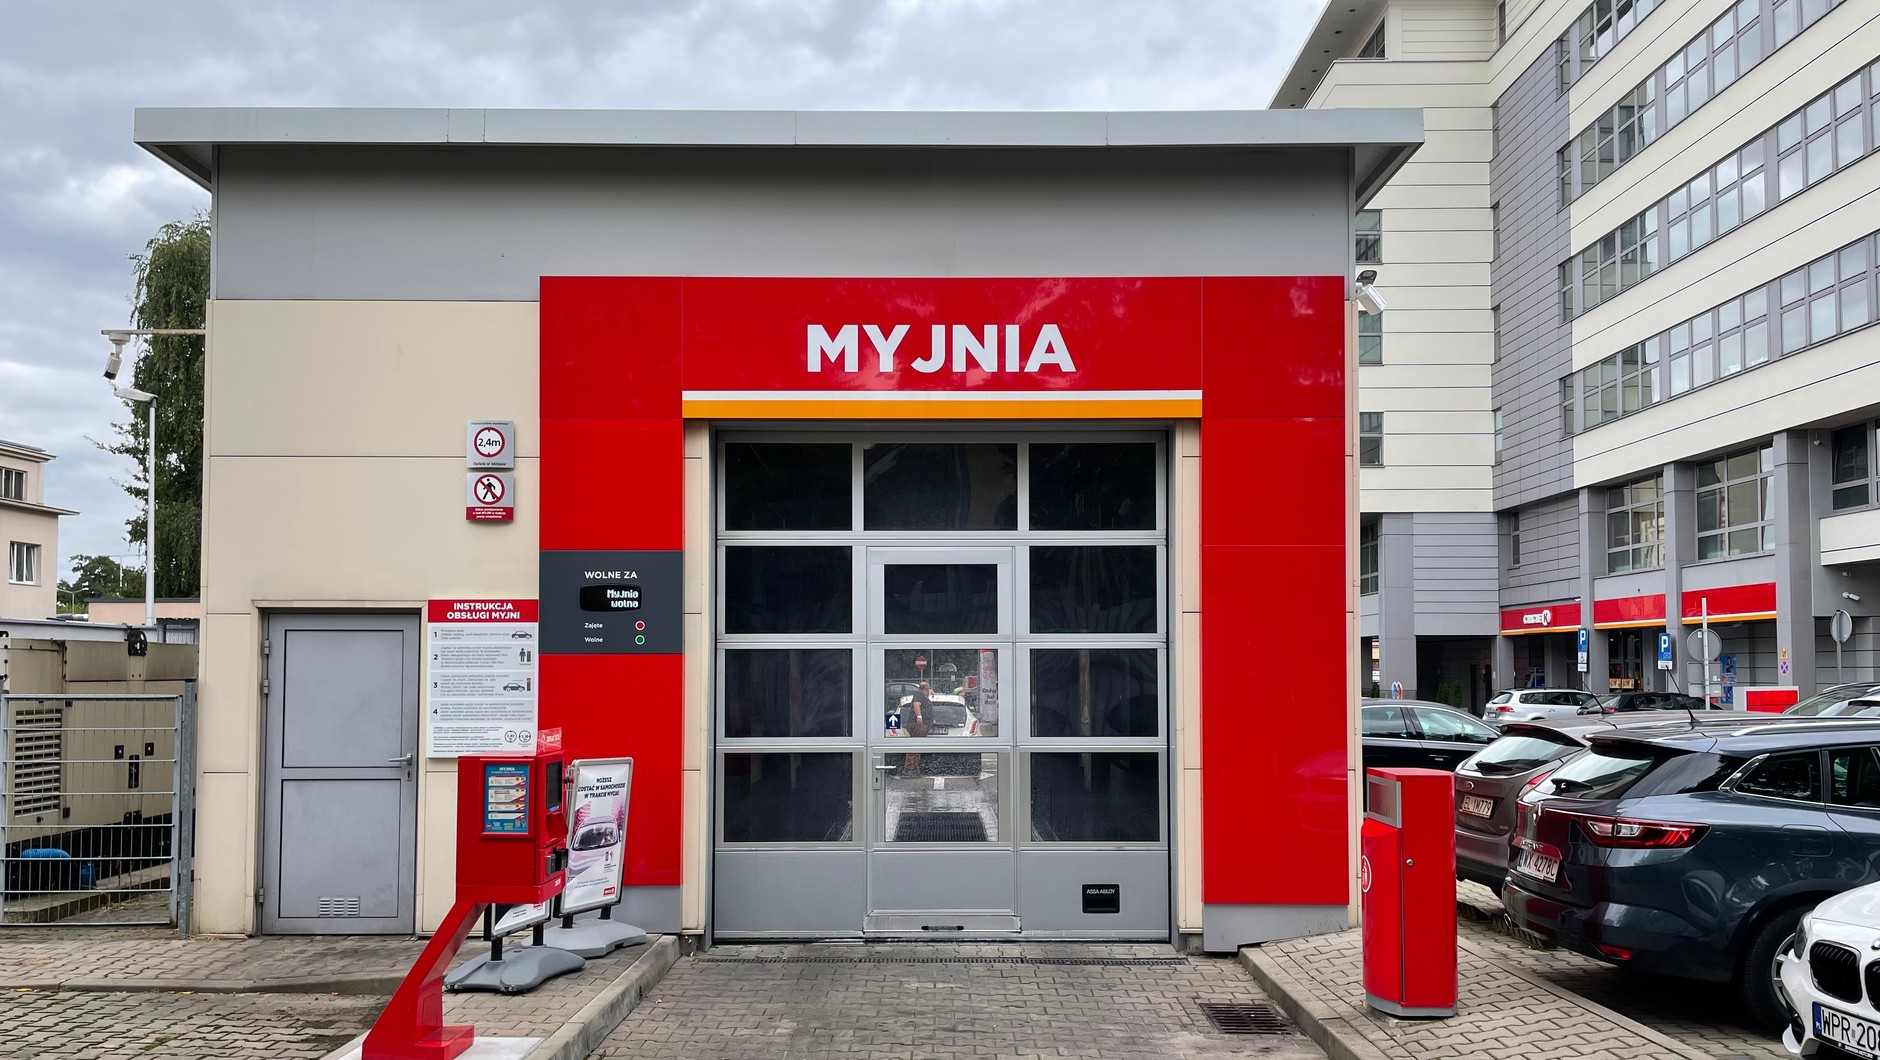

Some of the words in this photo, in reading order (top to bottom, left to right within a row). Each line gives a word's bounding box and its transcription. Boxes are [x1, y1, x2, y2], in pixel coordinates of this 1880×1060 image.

[807, 324, 1077, 373] MYJNIA
[478, 438, 501, 448] 2,4m
[584, 571, 621, 579] WOLNE
[623, 571, 638, 579] ZA
[453, 602, 513, 611] INSTRUKCJA
[610, 600, 639, 608] wolna
[446, 611, 489, 619] OBSŁUGI
[491, 611, 520, 619] MYJNI
[1580, 630, 1586, 645] P
[1661, 635, 1669, 652] P
[1534, 855, 1558, 877] 4278C
[1821, 1009, 1851, 1043] WPR
[1856, 1022, 1880, 1052] 20
